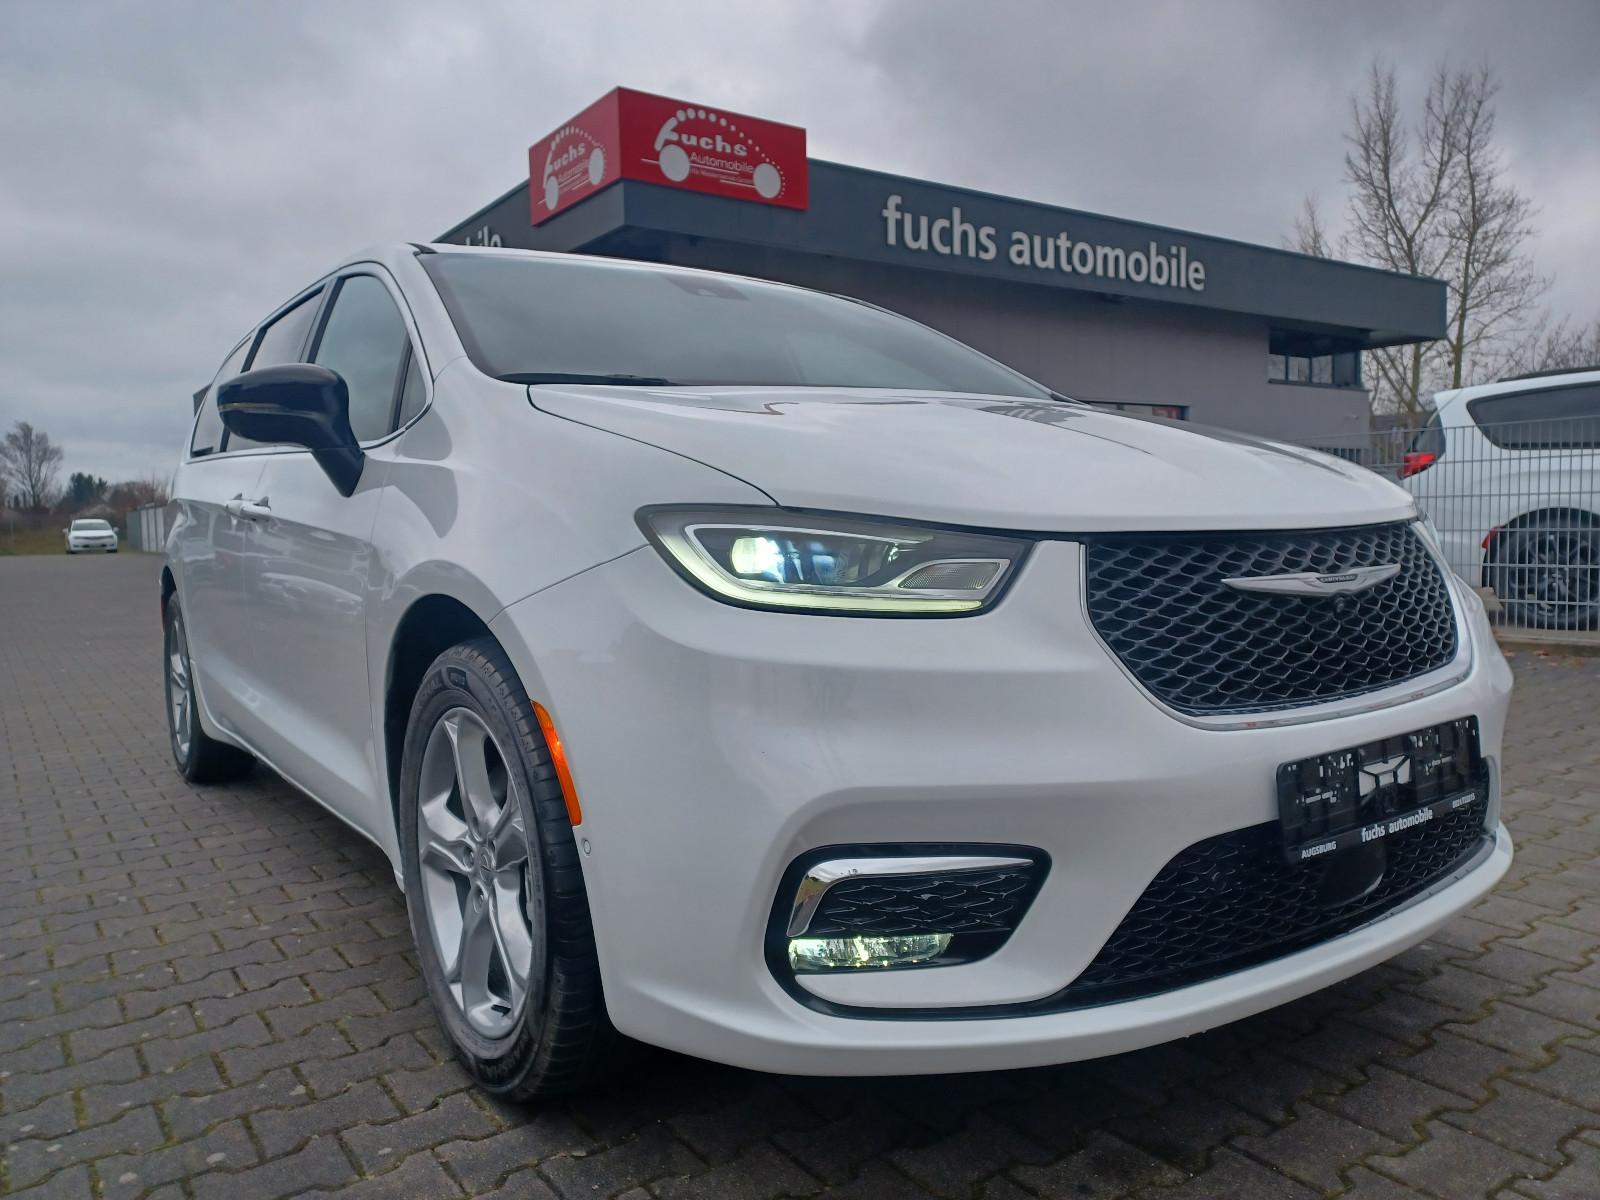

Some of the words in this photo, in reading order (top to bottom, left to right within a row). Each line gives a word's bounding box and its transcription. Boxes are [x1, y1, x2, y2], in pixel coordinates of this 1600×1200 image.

[654, 116, 748, 157] fuchs
[690, 151, 754, 173] Automobile
[882, 195, 998, 261] fuchs
[1009, 230, 1206, 291] automobile
[1361, 824, 1385, 843] fuchs
[1388, 807, 1433, 834] automobile
[1301, 841, 1337, 859] AUGSBURG
